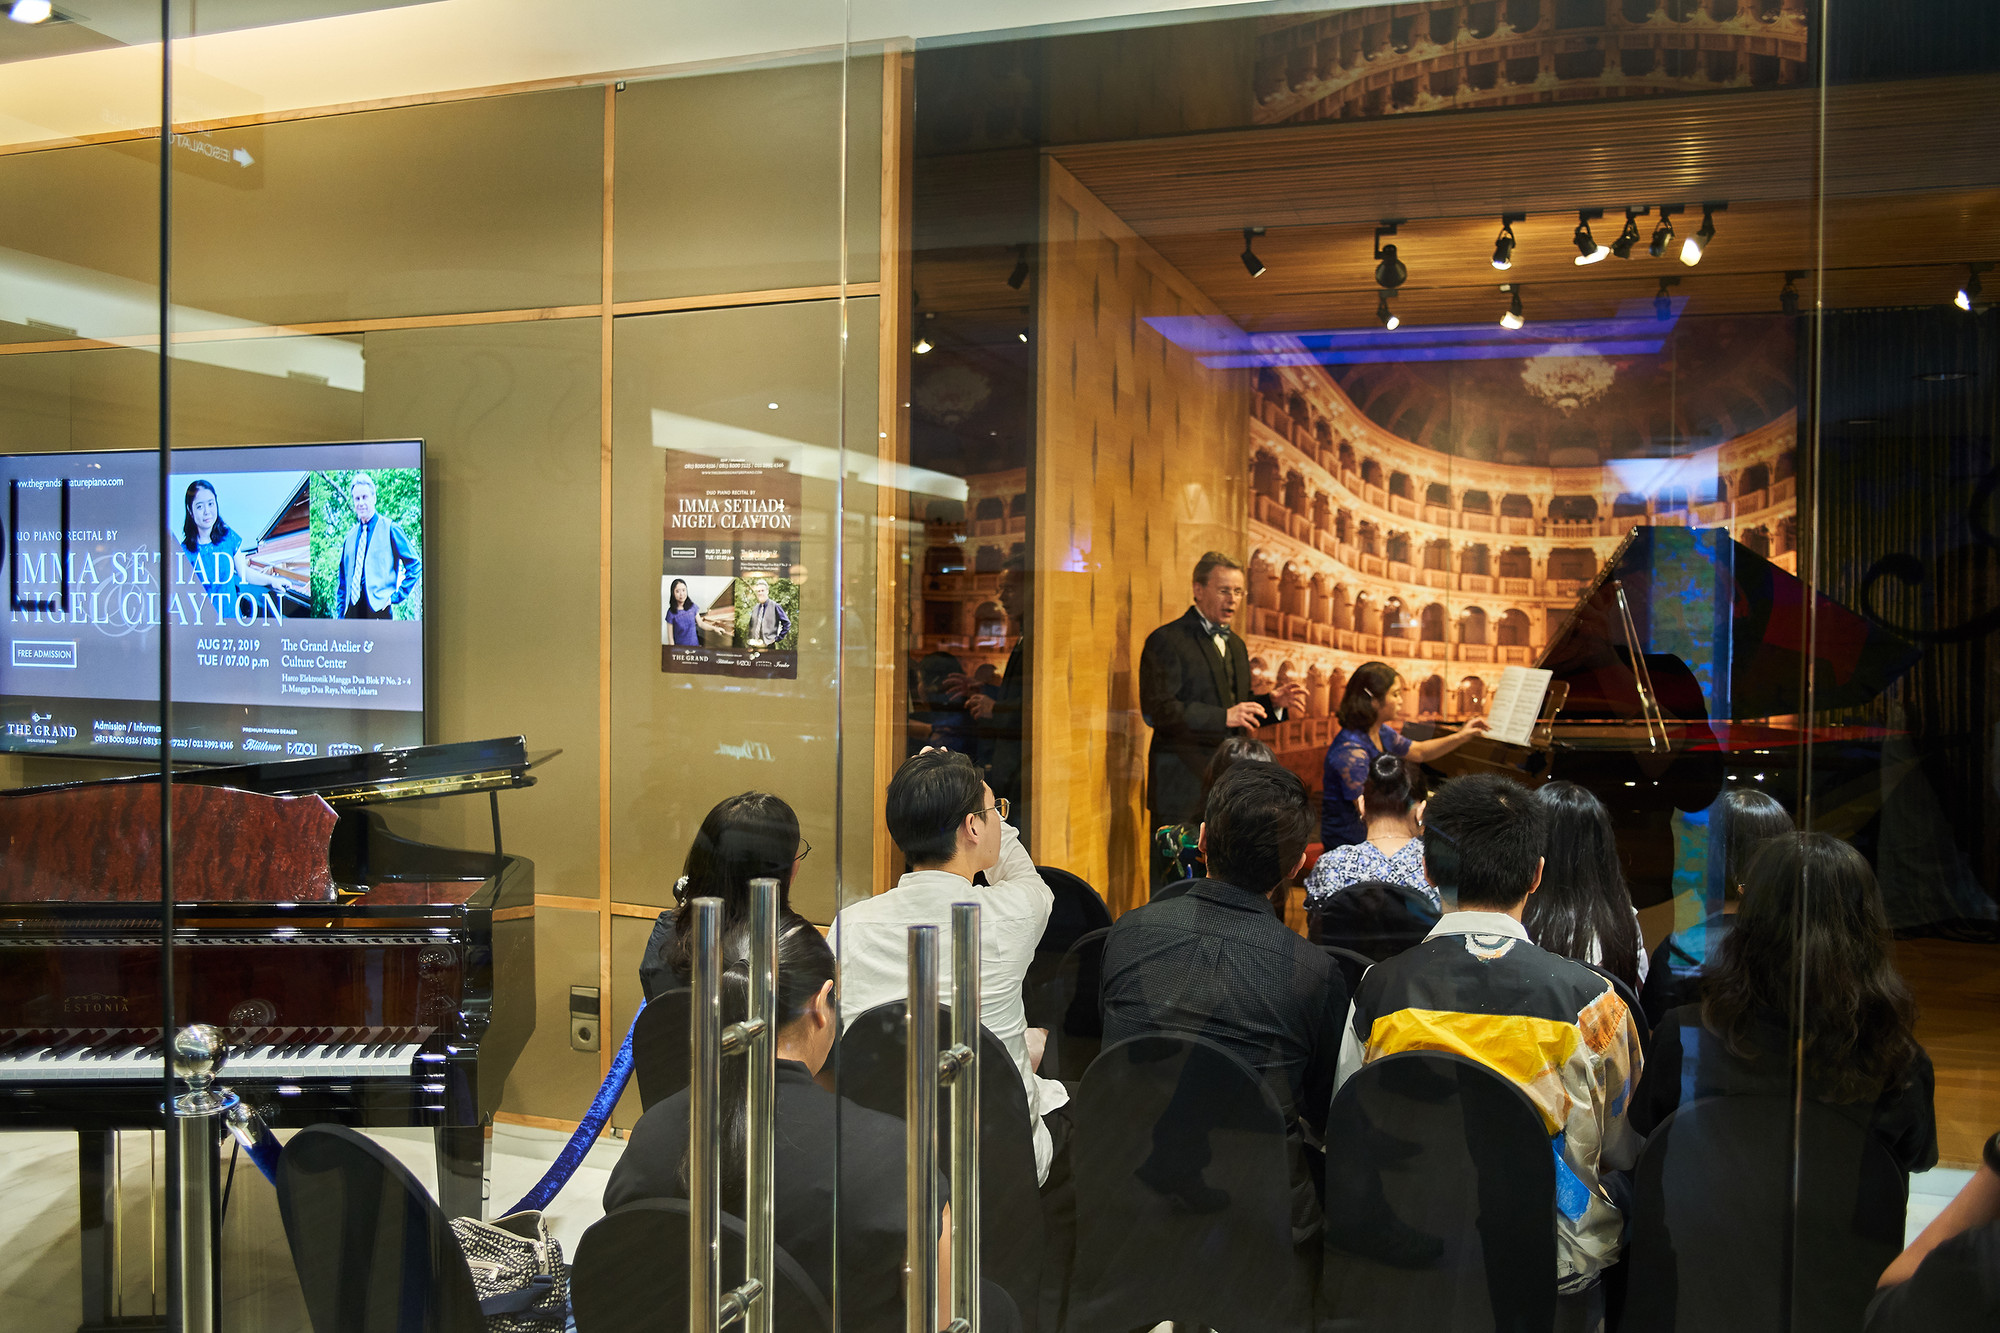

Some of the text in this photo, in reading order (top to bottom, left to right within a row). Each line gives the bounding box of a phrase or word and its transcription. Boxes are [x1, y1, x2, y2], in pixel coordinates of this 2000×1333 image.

[9, 477, 124, 490] ww.thegrandsiaturepiano.com
[679, 499, 785, 513] IMMA SETIADI
[672, 514, 792, 529] NIGEL CLAYTON
[16, 530, 31, 542] UO
[34, 530, 62, 542] PIANO
[107, 530, 118, 541] BY
[10, 551, 249, 585] MMA SEIADI
[11, 591, 285, 627] NIGEL CLAYTON
[197, 638, 260, 652] AUG 27, 2019
[281, 638, 374, 653] The Grand Atelier &
[17, 649, 72, 659] FREE ADMISSION
[197, 654, 270, 670] TUE / 07.00 p.m
[281, 654, 348, 669] Culture Center
[299, 674, 329, 683] Elektronik
[329, 675, 351, 686] Mangga
[352, 675, 365, 685] Dua
[366, 676, 380, 685] Blok
[406, 677, 412, 686] 4
[289, 684, 311, 695] Mangga
[311, 685, 324, 694] Dua
[325, 685, 340, 696] Raya,
[340, 686, 358, 695] North
[358, 686, 378, 696] Jakarta
[7, 723, 78, 738] THE GRAND
[94, 720, 127, 731] Admission
[133, 722, 162, 733] Informa
[94, 734, 109, 744] 0813
[109, 735, 125, 744] 8000
[64, 1003, 129, 1013] ESTONIA
